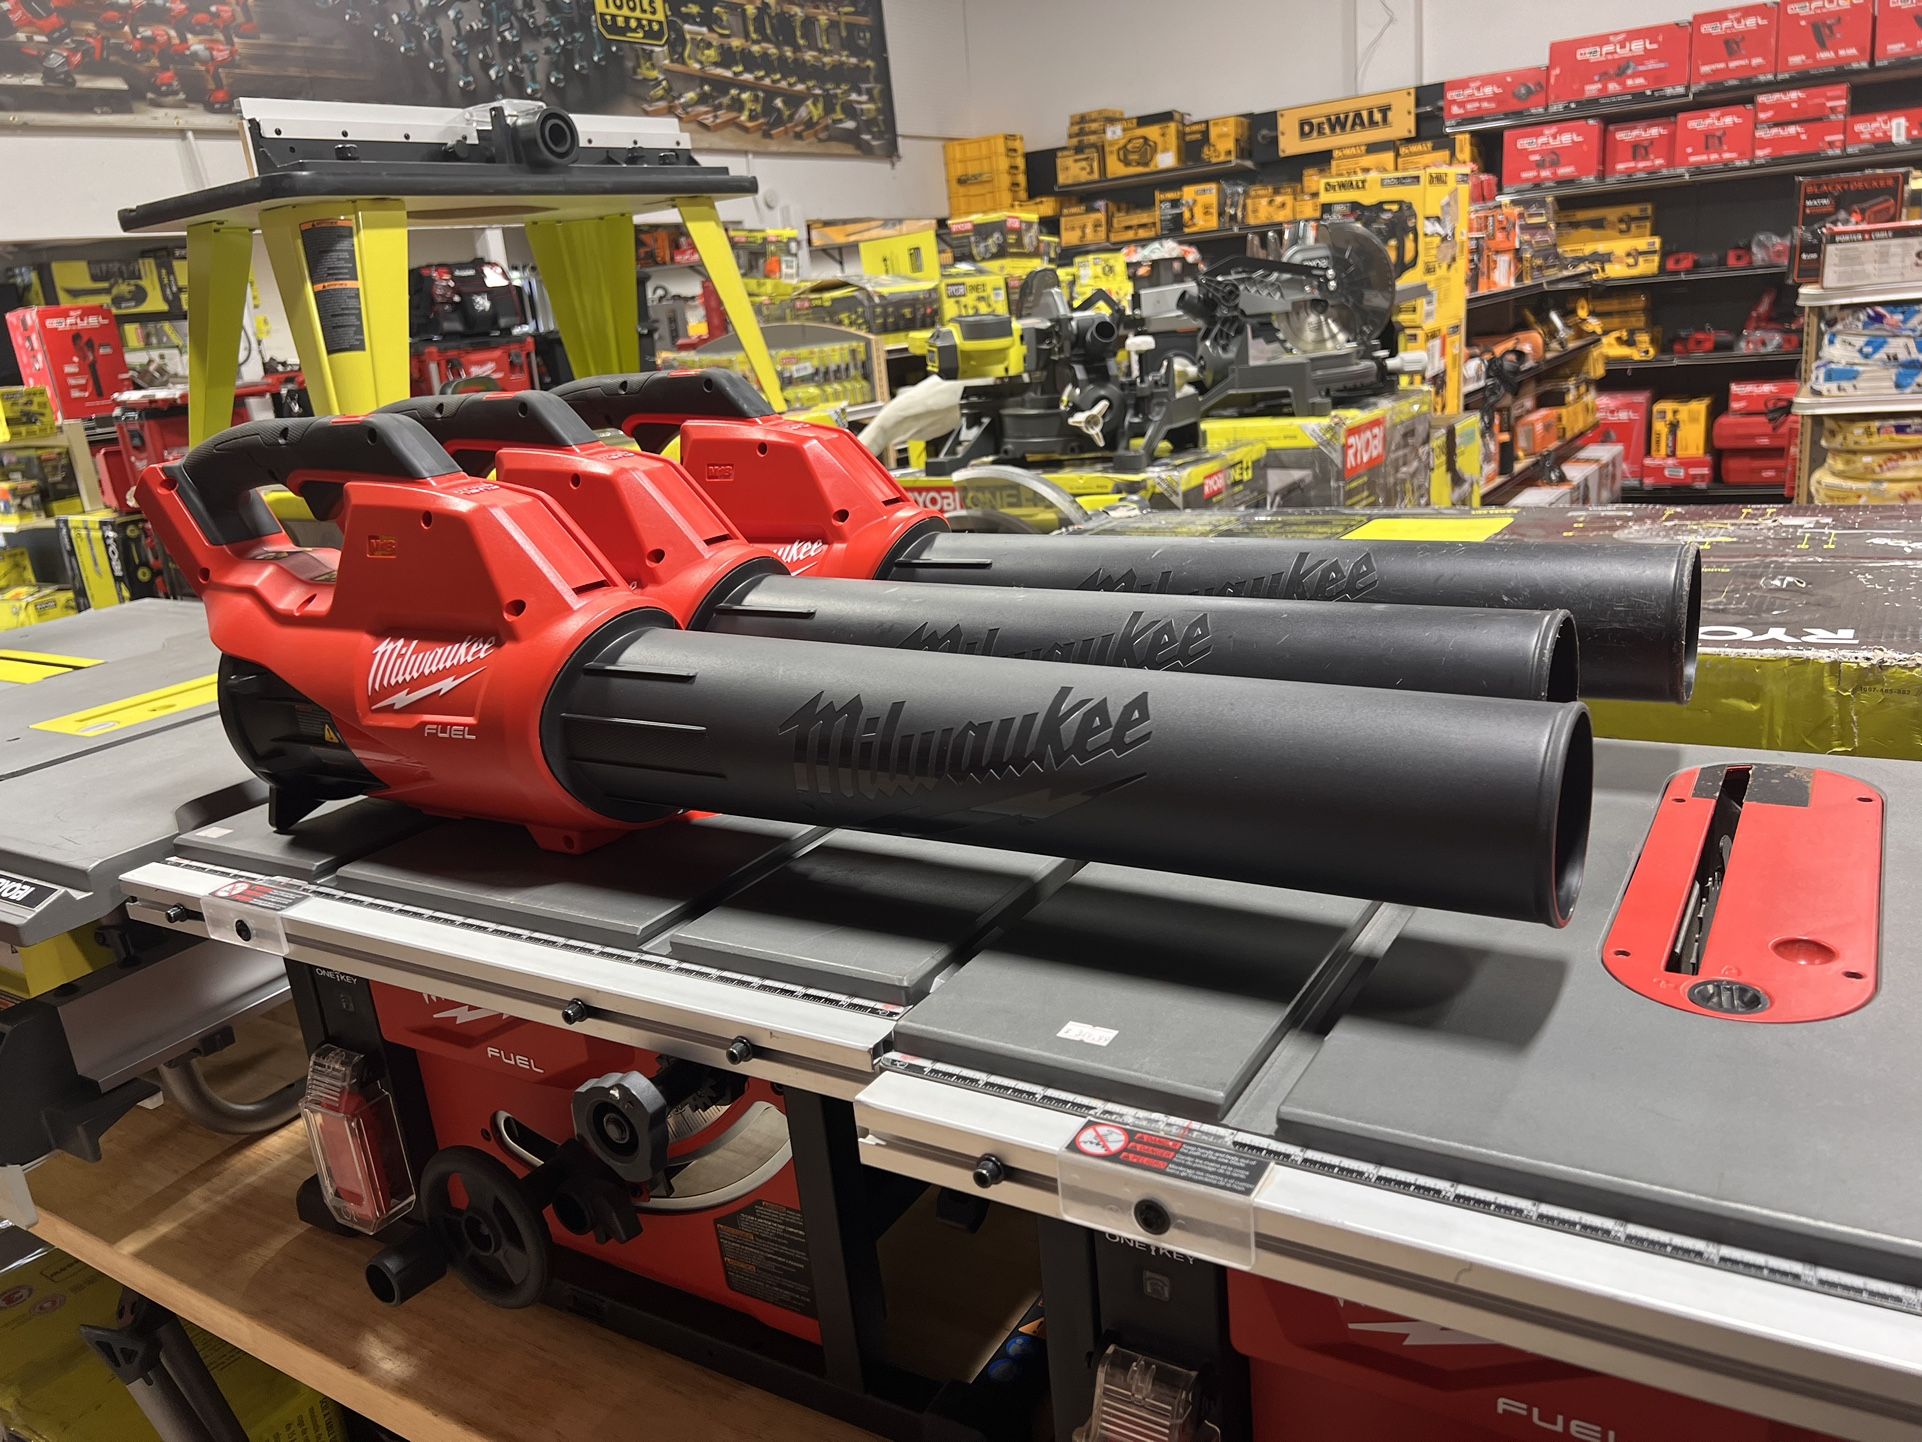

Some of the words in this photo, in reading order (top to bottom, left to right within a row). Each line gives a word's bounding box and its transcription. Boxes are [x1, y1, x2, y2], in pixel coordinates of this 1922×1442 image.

[1721, 15, 1769, 29] FUEL
[1602, 39, 1659, 55] FUEL
[1463, 86, 1503, 98] FUEL
[1704, 115, 1743, 126] FUEL
[1537, 132, 1584, 148] FUEL
[1633, 127, 1669, 138] FUEL
[1324, 179, 1367, 193] DEWALT
[67, 316, 110, 326] FUEL
[1347, 426, 1384, 468] RYOBI
[368, 635, 496, 696] Milwaukee
[424, 724, 477, 740] FUEL
[778, 686, 1153, 800] Milwaukee
[486, 1046, 545, 1074] FUEL
